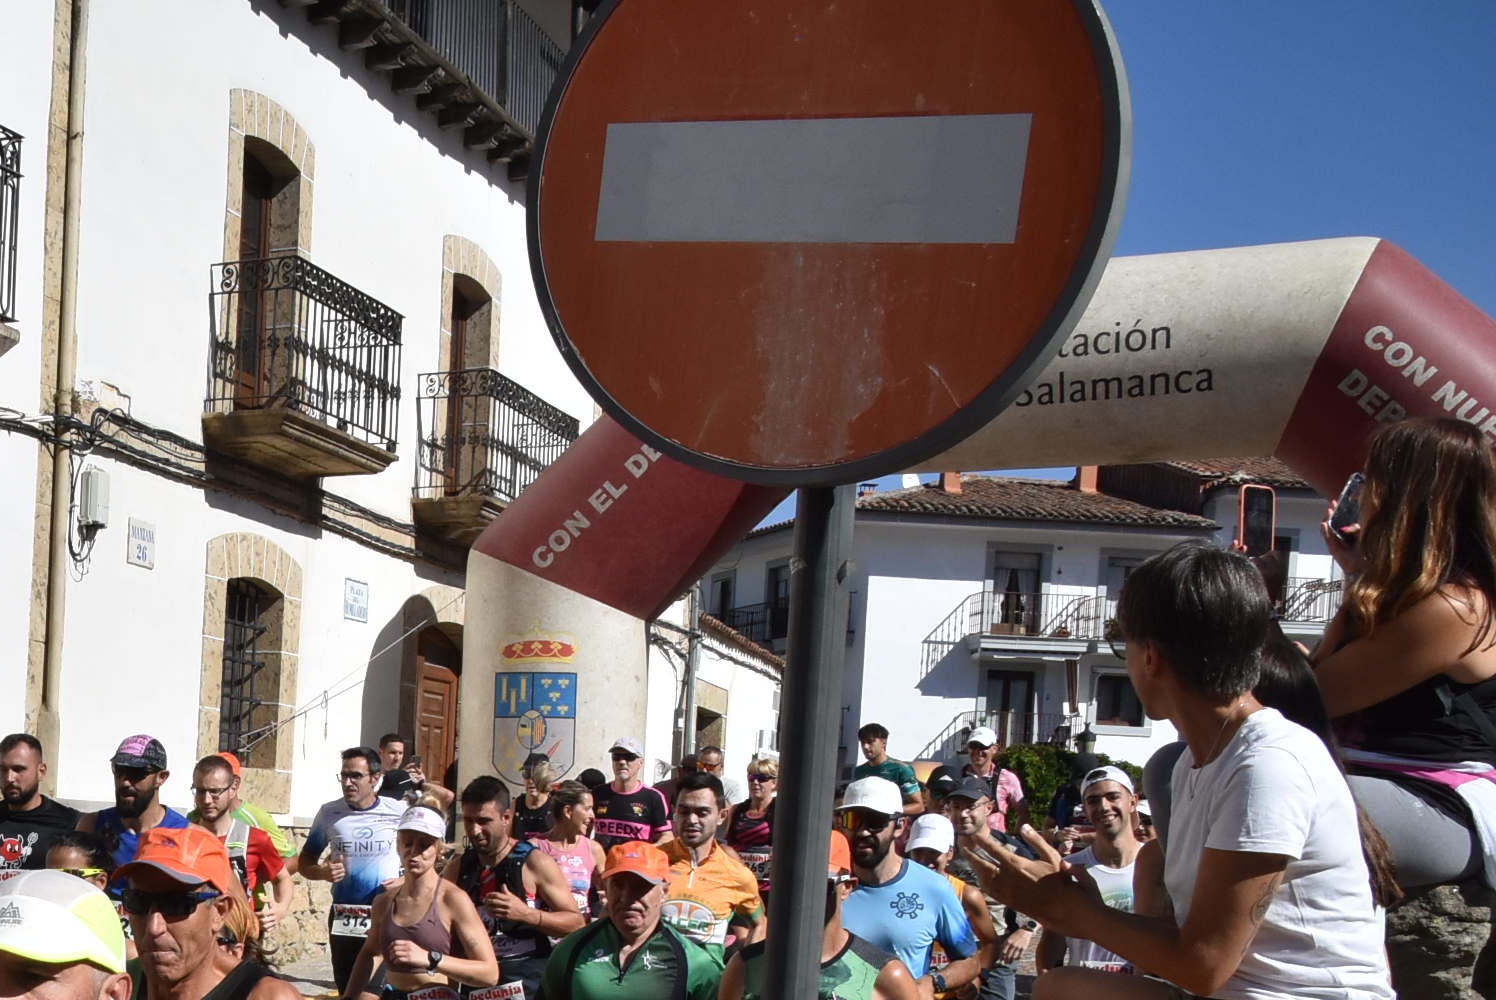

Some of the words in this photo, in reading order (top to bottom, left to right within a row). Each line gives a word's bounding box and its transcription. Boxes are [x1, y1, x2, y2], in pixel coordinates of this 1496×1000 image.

[1364, 325, 1439, 388] CON
[137, 543, 147, 562] 26
[532, 510, 591, 568] CON
[587, 480, 629, 514] EL
